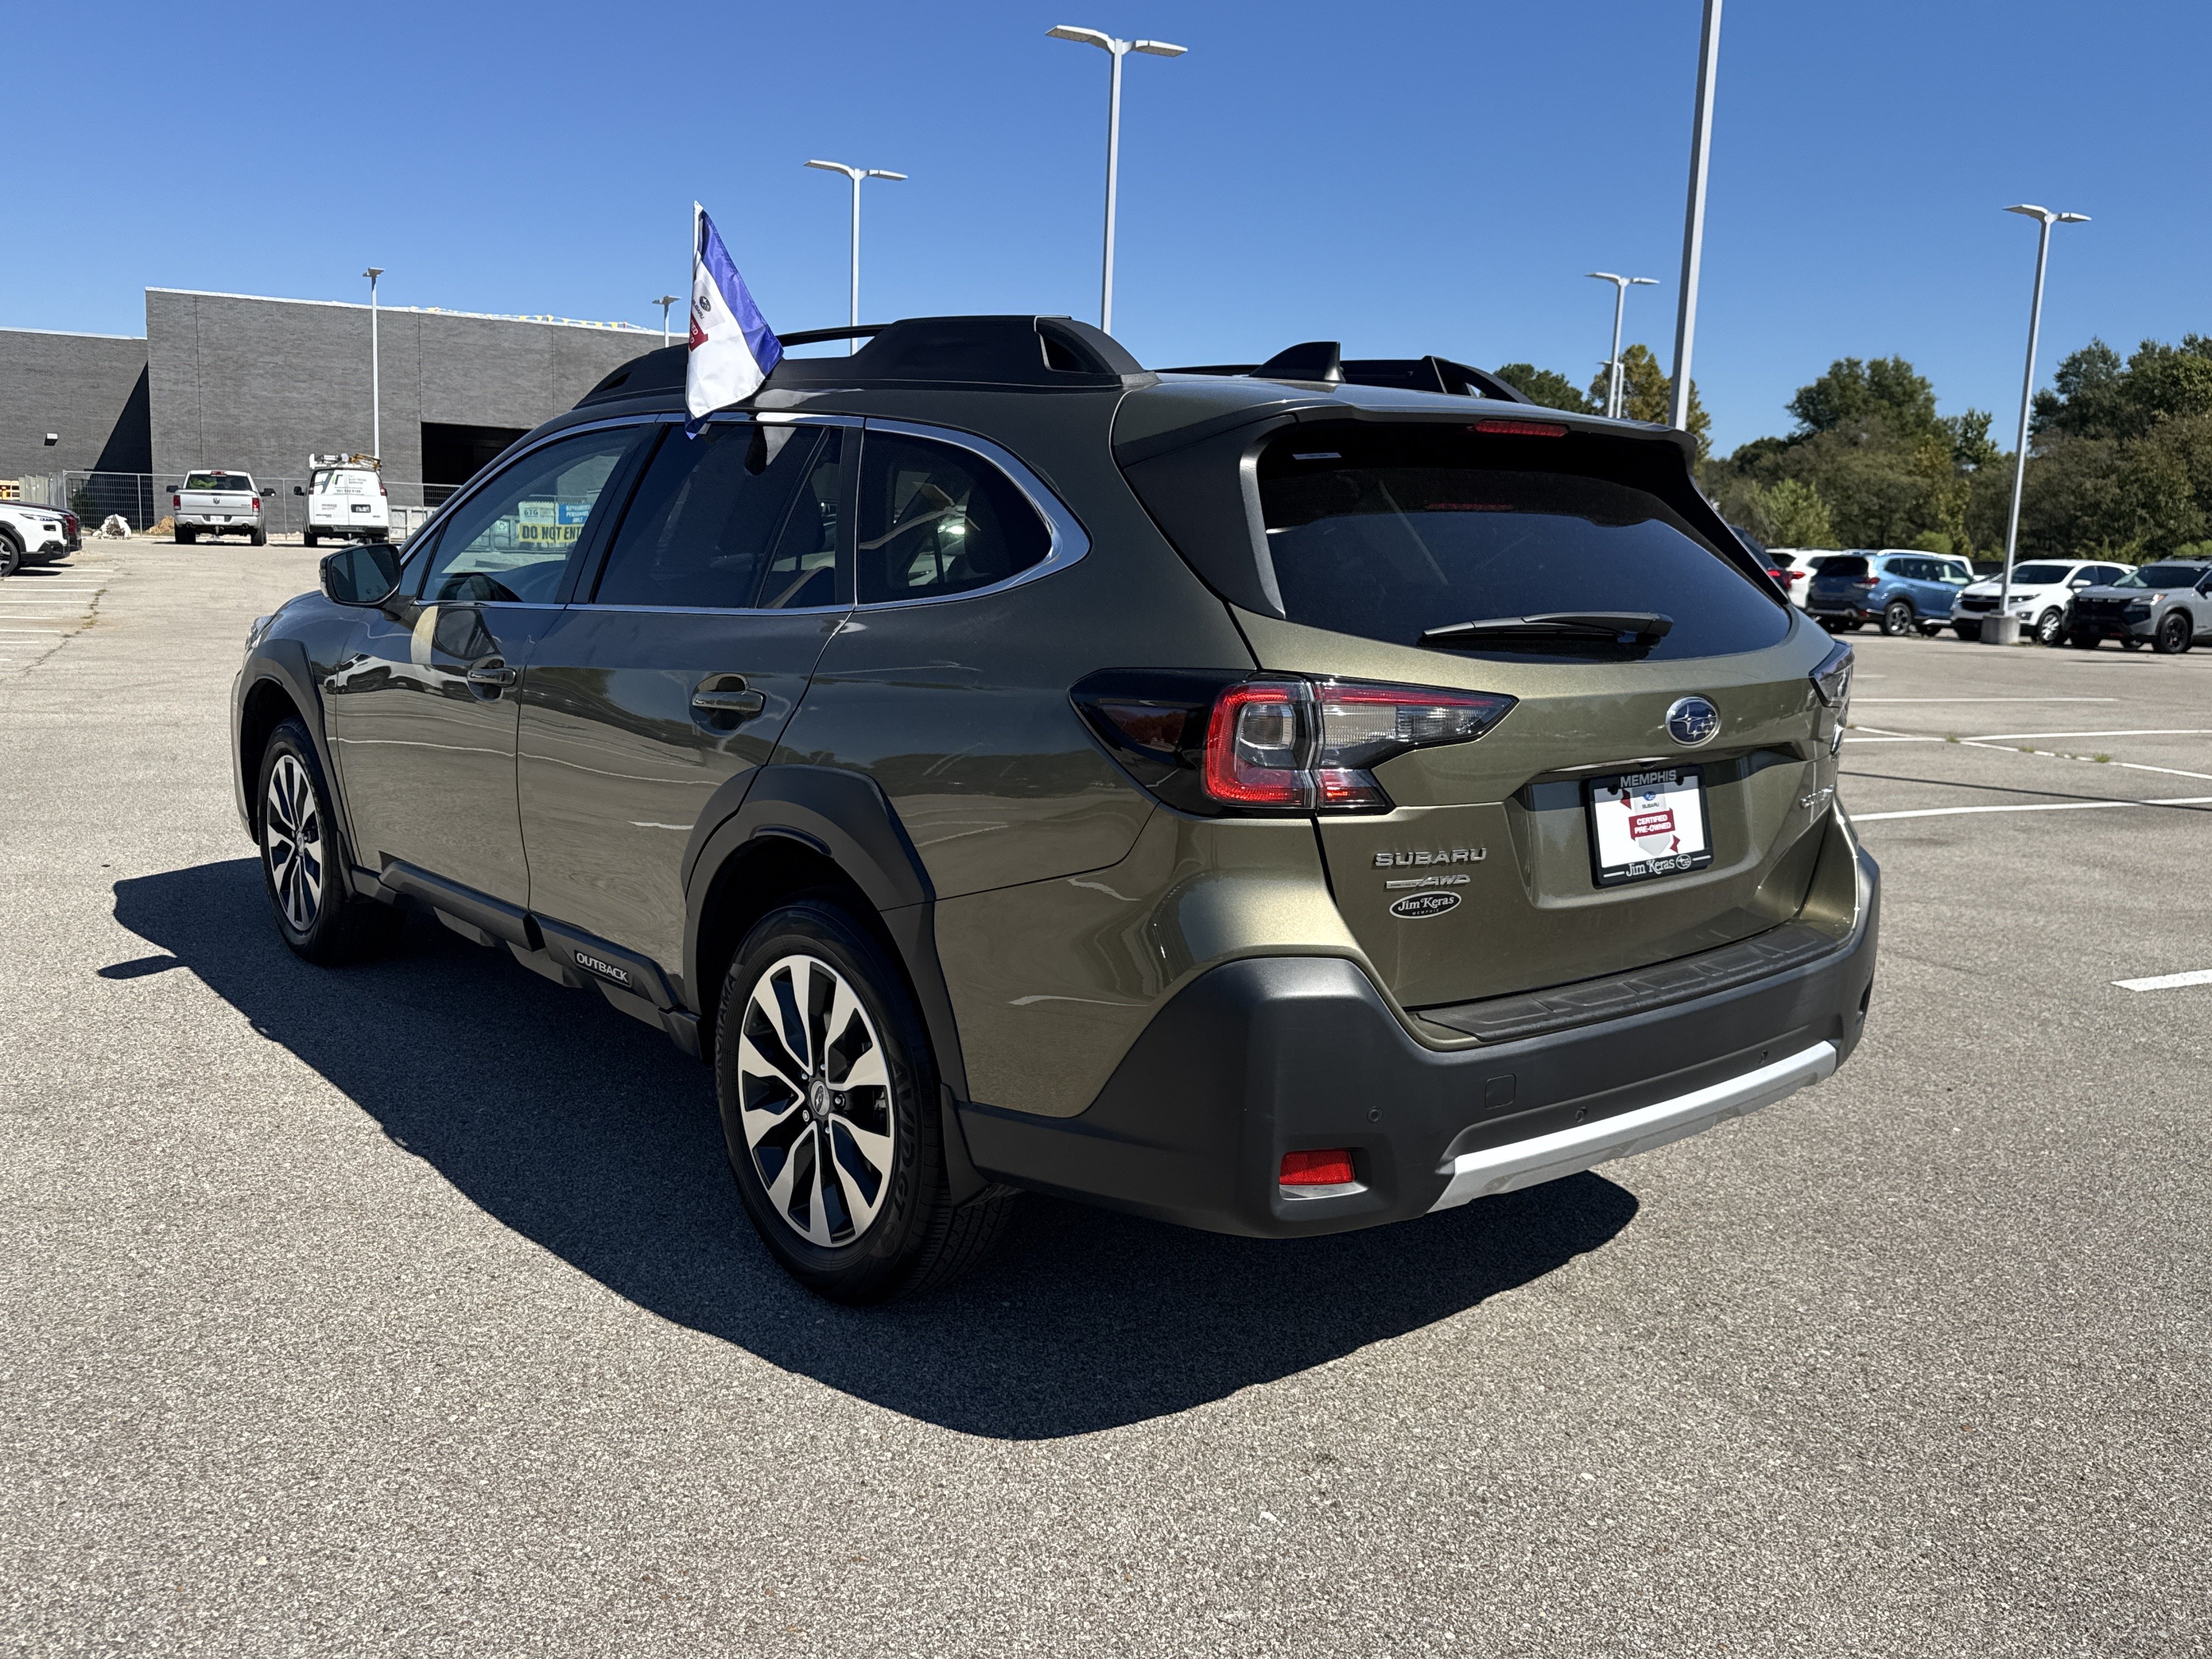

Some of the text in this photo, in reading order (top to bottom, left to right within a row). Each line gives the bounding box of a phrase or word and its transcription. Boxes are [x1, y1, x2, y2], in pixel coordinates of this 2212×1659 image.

[523, 525, 584, 540] DO NOT ENT
[1620, 769, 1677, 788] MEMPHIS
[1637, 814, 1668, 825] CERTIFIED
[1634, 822, 1672, 834] PRE-OWNED
[1375, 848, 1487, 867] SUBARU
[1626, 858, 1675, 877] Jim Keras
[1418, 874, 1471, 887] AWD
[1397, 896, 1454, 911] Jim Keras
[577, 952, 629, 983] OUTBACK
